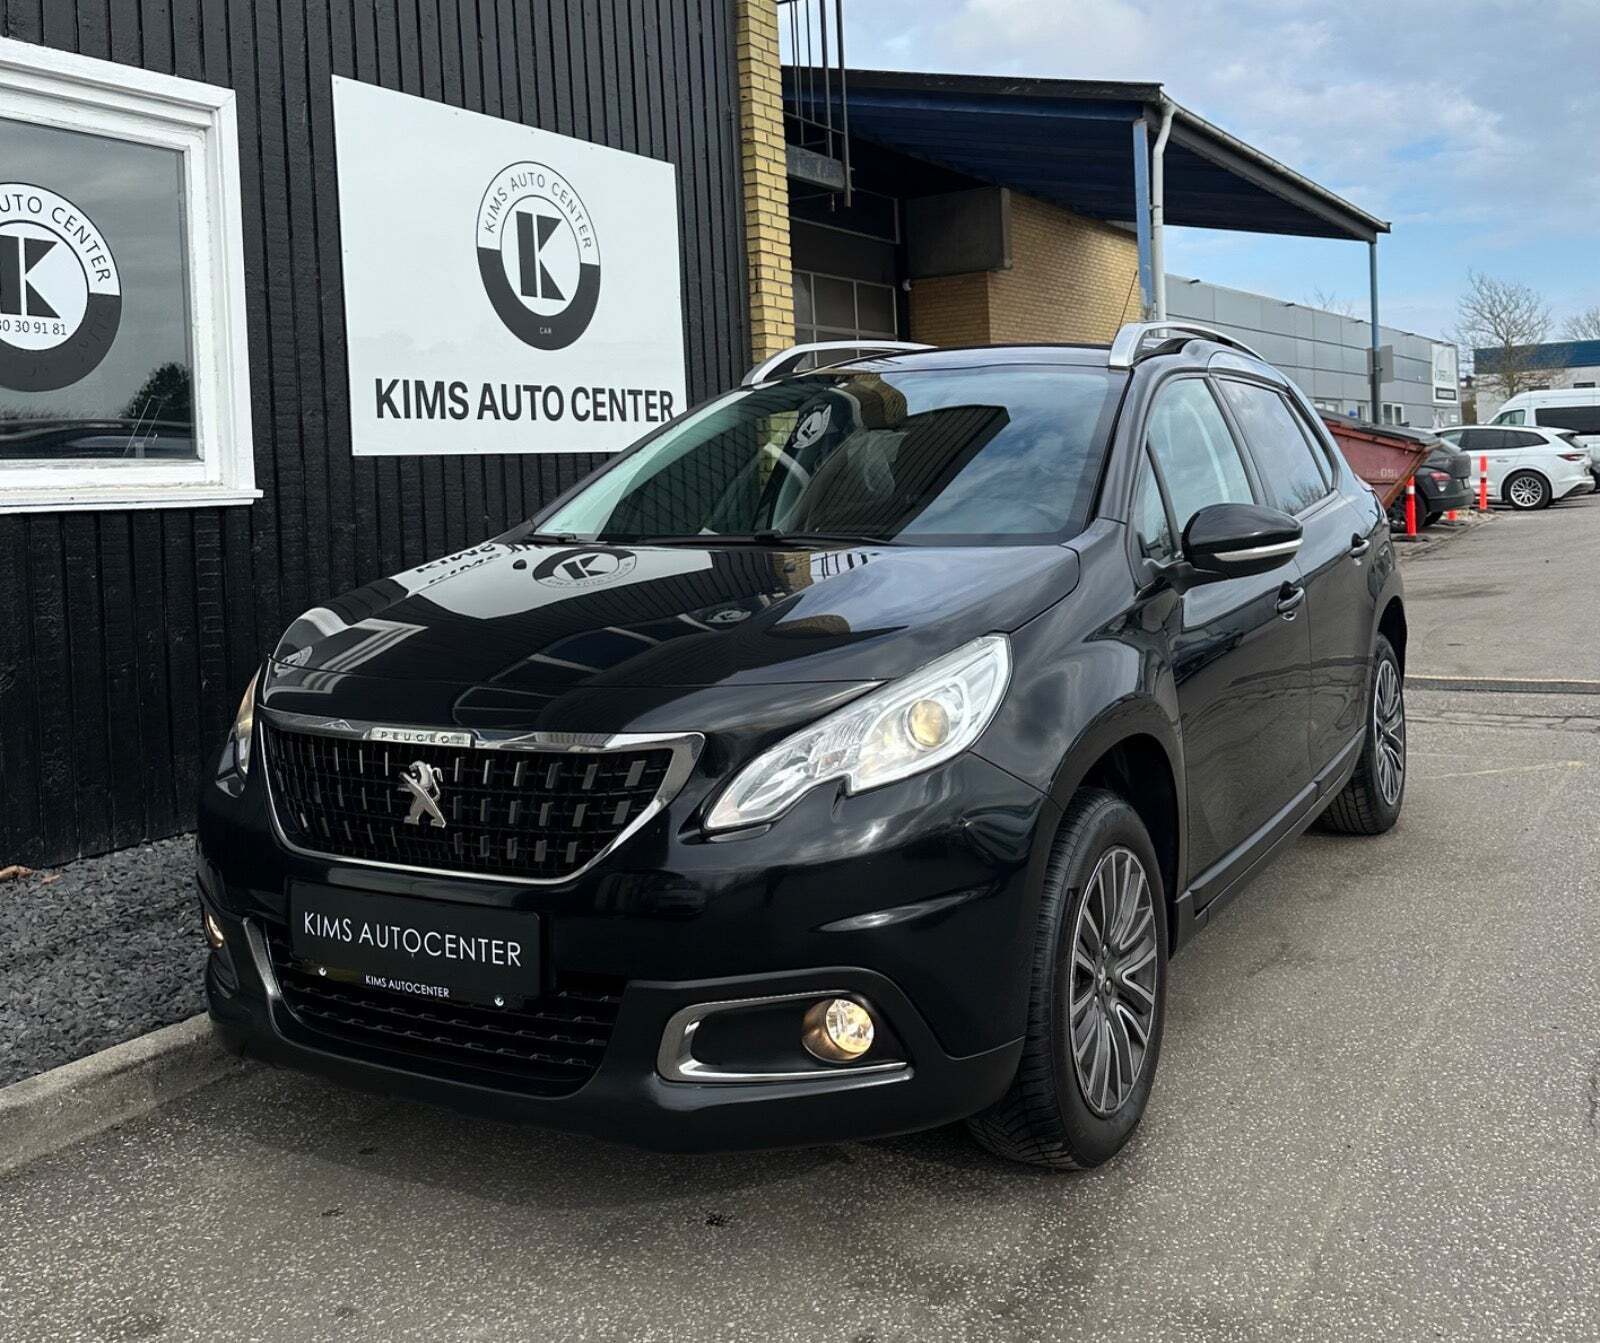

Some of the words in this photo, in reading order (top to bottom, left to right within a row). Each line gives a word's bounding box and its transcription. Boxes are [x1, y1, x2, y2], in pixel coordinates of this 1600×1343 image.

[484, 187, 508, 234] KIMS
[510, 172, 545, 192] AUTO
[551, 182, 592, 249] CENTER
[51, 207, 111, 282] CENTER
[0, 320, 10, 331] 0
[15, 320, 30, 332] 30
[34, 322, 48, 334] 91
[52, 323, 67, 335] 81
[375, 378, 469, 420] KIMS
[477, 383, 565, 421] AUTO
[571, 386, 674, 422] CENTER
[304, 912, 353, 942] KIMS
[358, 922, 522, 967] AUTOCENTER
[365, 974, 387, 988] KIMS
[388, 979, 450, 998] AUTOCENTER
